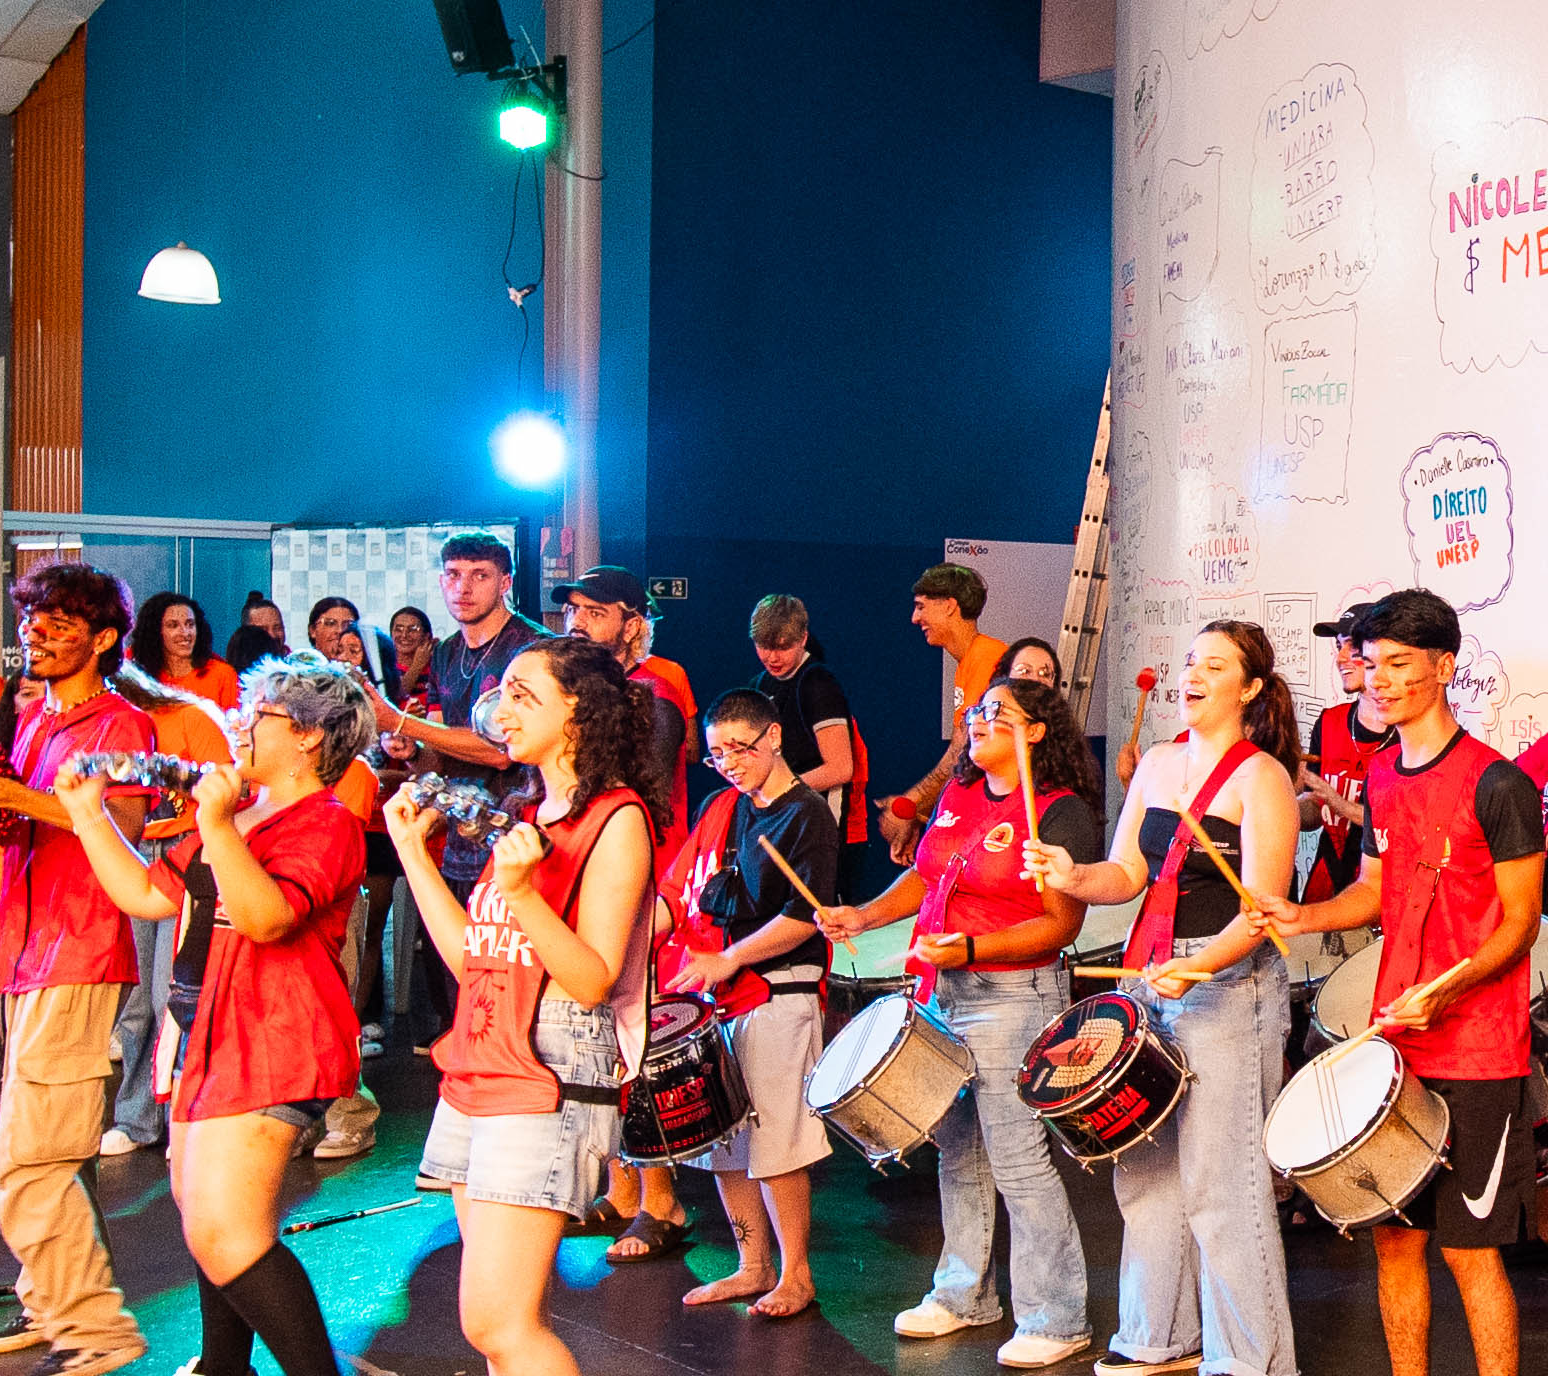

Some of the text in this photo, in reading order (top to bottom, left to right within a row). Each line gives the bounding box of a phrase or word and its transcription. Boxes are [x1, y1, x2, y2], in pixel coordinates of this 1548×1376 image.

[1283, 414, 1324, 448] USP
[1446, 519, 1477, 543] UEL
[1437, 538, 1481, 569] UNESP
